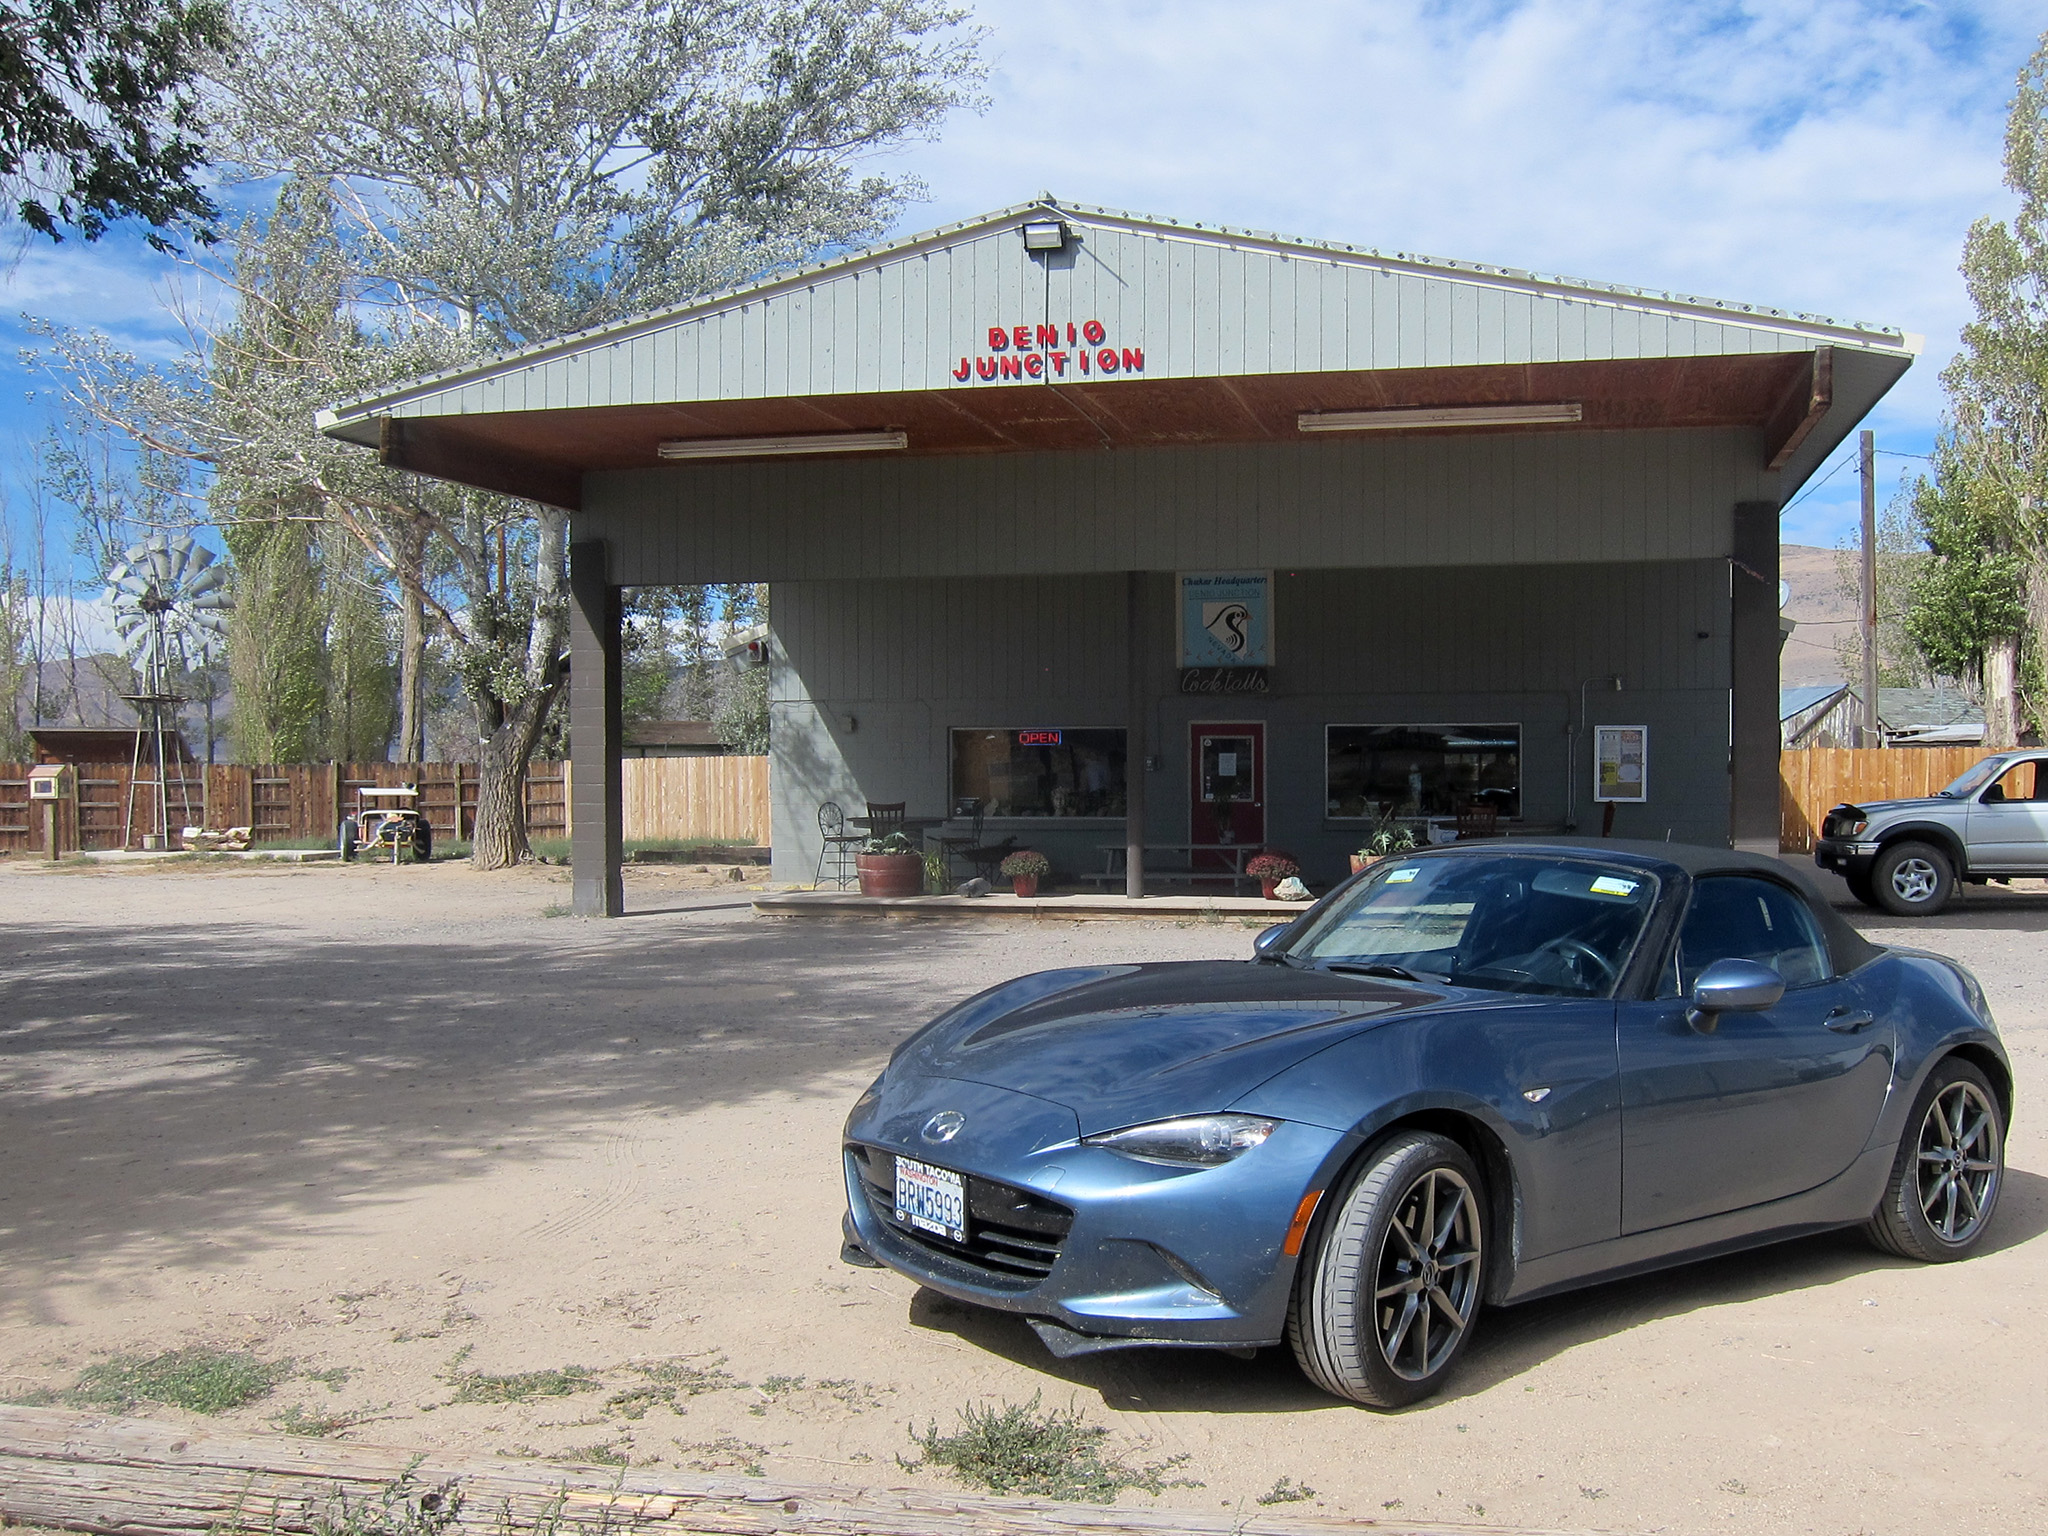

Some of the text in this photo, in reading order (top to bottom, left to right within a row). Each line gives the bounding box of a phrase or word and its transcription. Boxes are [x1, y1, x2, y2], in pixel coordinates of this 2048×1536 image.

[988, 320, 1106, 352] DENIO
[952, 348, 1144, 382] JUNCTION
[1214, 576, 1267, 586] Headquarters
[1208, 636, 1237, 664] NEVADA
[1019, 733, 1059, 744] OPEN
[895, 1155, 962, 1186] SOUTH TACOMA
[900, 1167, 939, 1187] WASHINGTON
[899, 1178, 962, 1228] BRW5993
